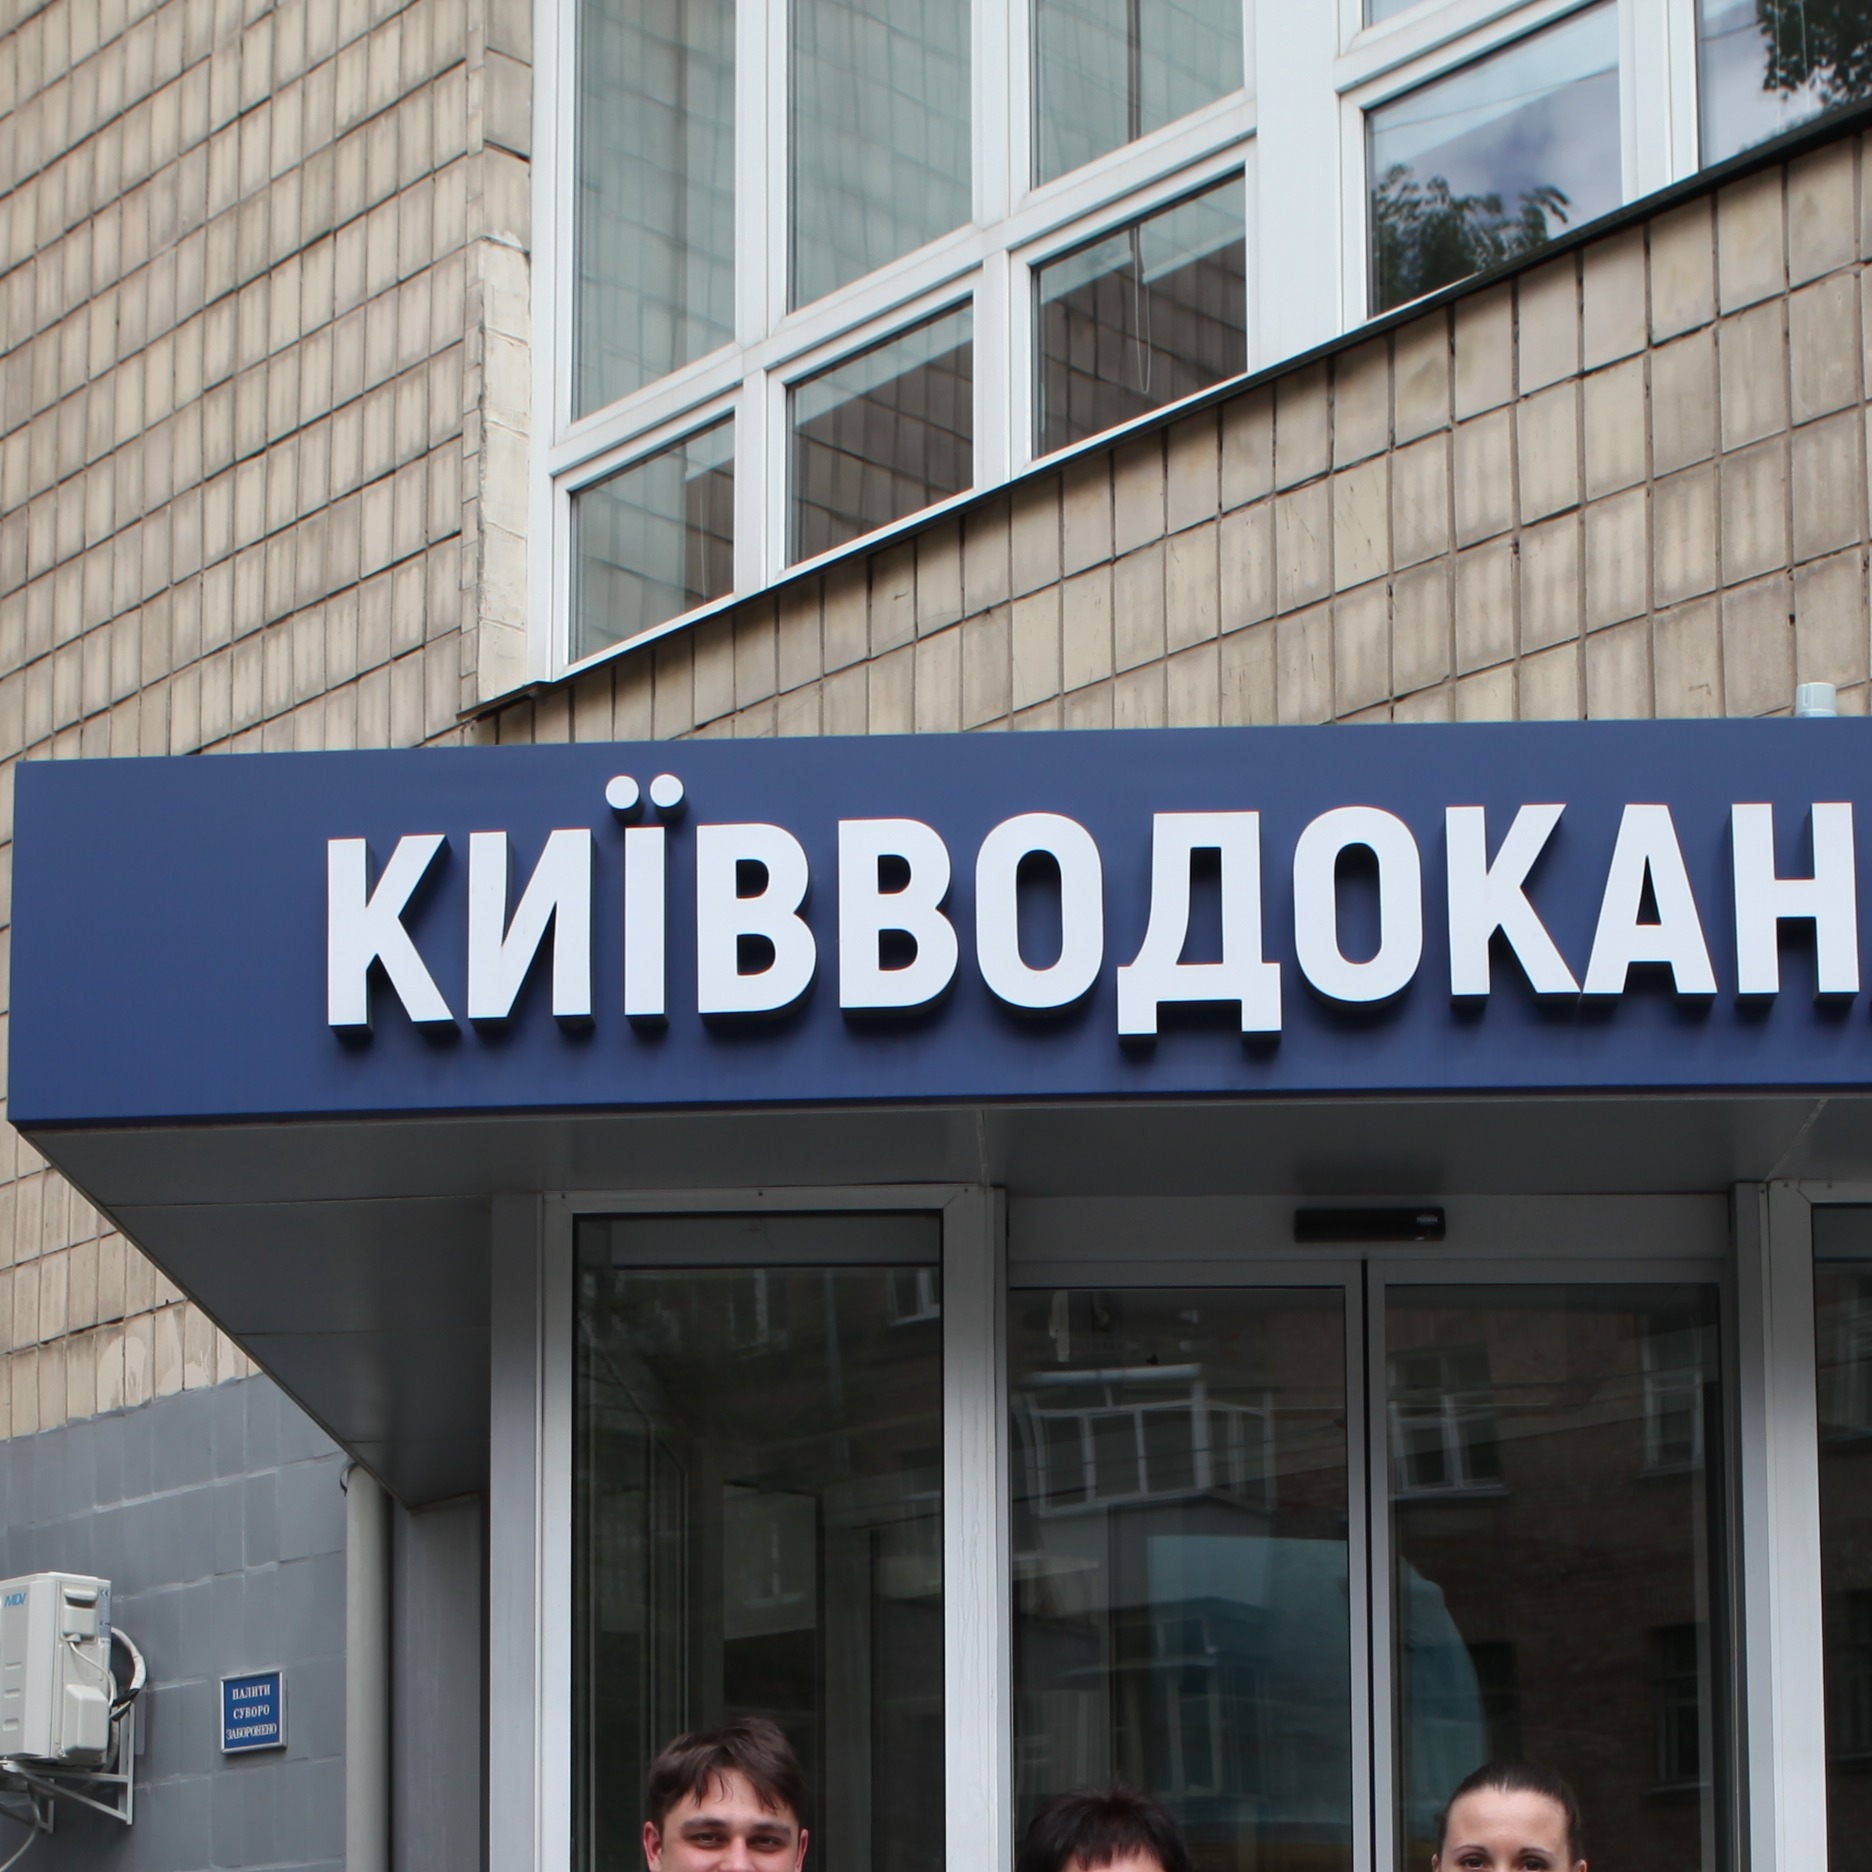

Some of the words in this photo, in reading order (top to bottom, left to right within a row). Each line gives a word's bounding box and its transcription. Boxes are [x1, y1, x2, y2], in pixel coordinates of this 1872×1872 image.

[4, 1592, 27, 1608] MDV
[232, 1684, 271, 1700] ПАЛИТИ
[233, 1704, 270, 1720] СУВОРО
[226, 1723, 278, 1740] ЗАБОРОНЕНО
